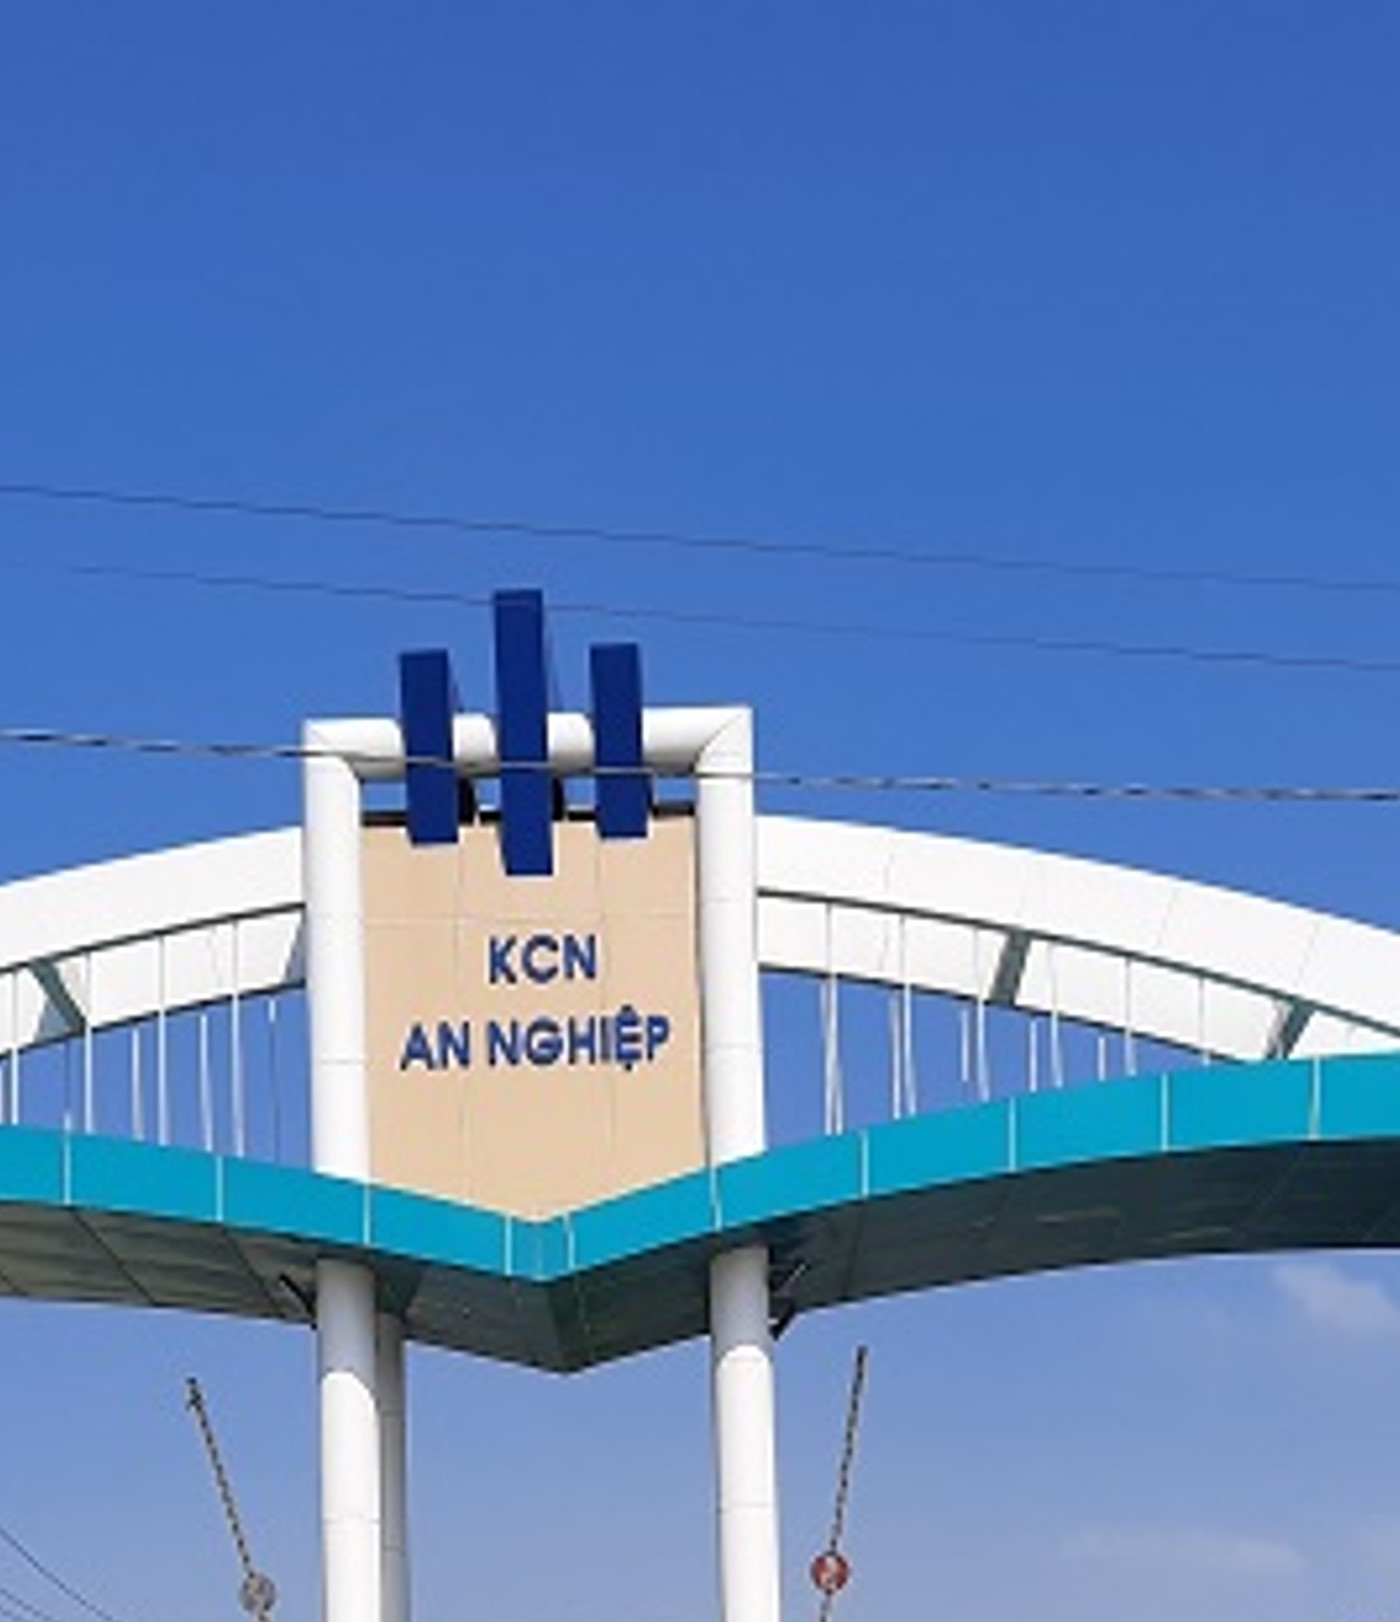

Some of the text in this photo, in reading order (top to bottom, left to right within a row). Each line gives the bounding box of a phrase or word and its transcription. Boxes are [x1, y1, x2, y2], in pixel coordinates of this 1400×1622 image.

[489, 933, 597, 985] KCN
[399, 1004, 671, 1072] AN NGHIỆP
